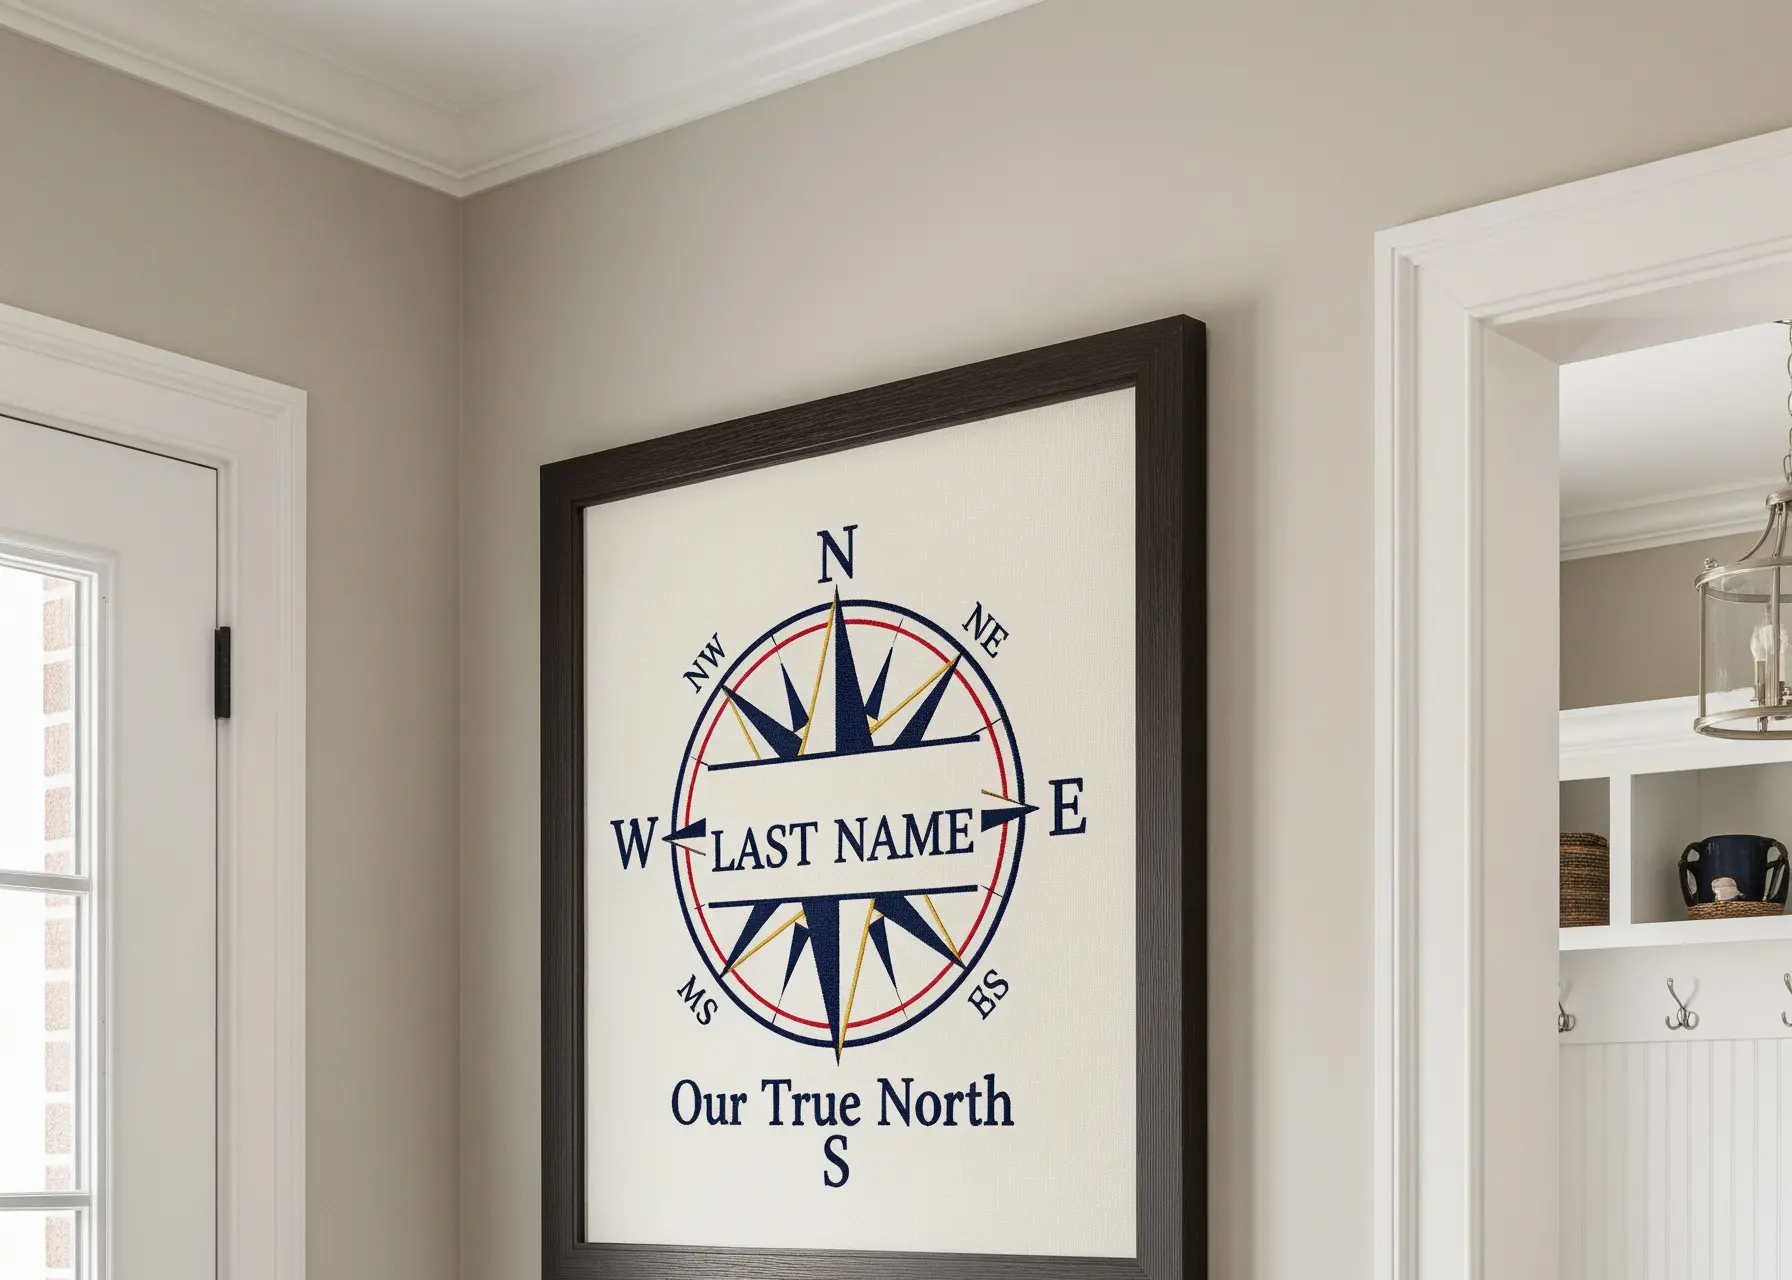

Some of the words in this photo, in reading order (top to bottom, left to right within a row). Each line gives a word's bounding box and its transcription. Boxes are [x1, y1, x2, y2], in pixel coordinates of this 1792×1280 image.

[815, 523, 860, 585] N
[961, 600, 1011, 660] NE
[681, 630, 727, 696] NW
[1047, 776, 1088, 838] E
[609, 815, 660, 871] W
[710, 822, 820, 873] LAST
[833, 808, 975, 864] NAME
[670, 1078, 749, 1127] Our
[760, 1077, 862, 1128] True
[876, 1072, 1016, 1128] North
[822, 1133, 851, 1189] S
